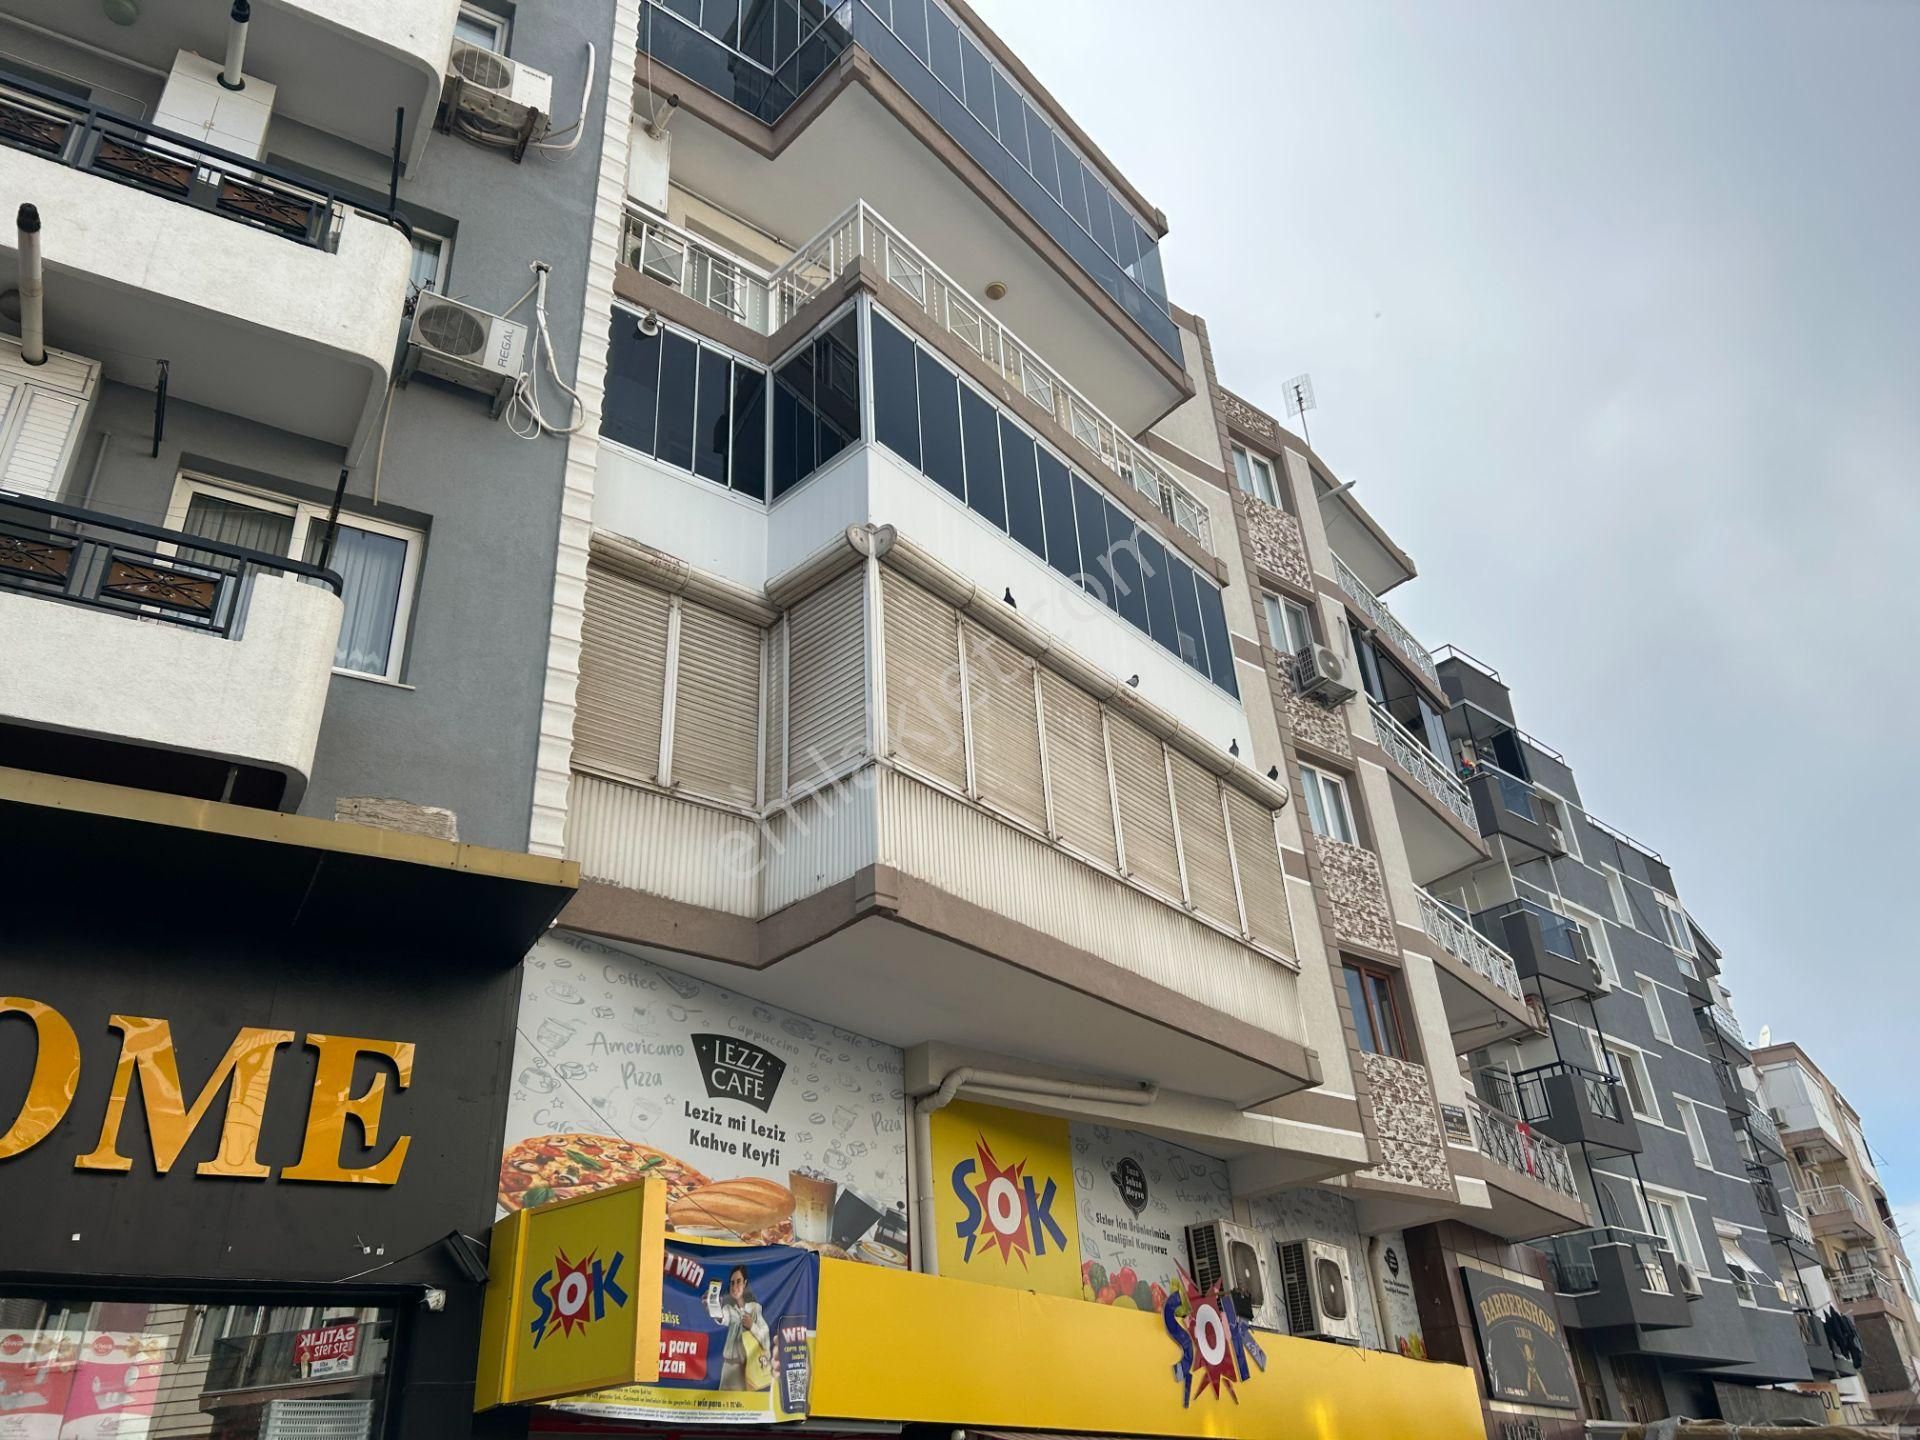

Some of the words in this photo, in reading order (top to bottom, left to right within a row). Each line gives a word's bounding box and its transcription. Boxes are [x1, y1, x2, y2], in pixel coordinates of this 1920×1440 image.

[498, 329, 514, 368] REGAL
[602, 964, 658, 992] Coffee
[586, 1031, 686, 1058] Americano
[727, 1015, 800, 1055] Cappuccino
[620, 1061, 663, 1091] Pizza
[714, 1039, 765, 1077] LEZZ
[711, 1067, 766, 1101] CAFE
[684, 1100, 723, 1126] Leziz
[727, 1114, 747, 1132] mi
[750, 1118, 786, 1143] Leziz
[689, 1128, 738, 1156] Kahve
[742, 1142, 781, 1168] Keyfi
[951, 1158, 1068, 1264] ŞOK
[530, 1250, 628, 1350] ŞOK
[1479, 1292, 1556, 1338] BARBERSHOP
[668, 1339, 698, 1358] para
[1163, 1291, 1267, 1409] ŞOK
